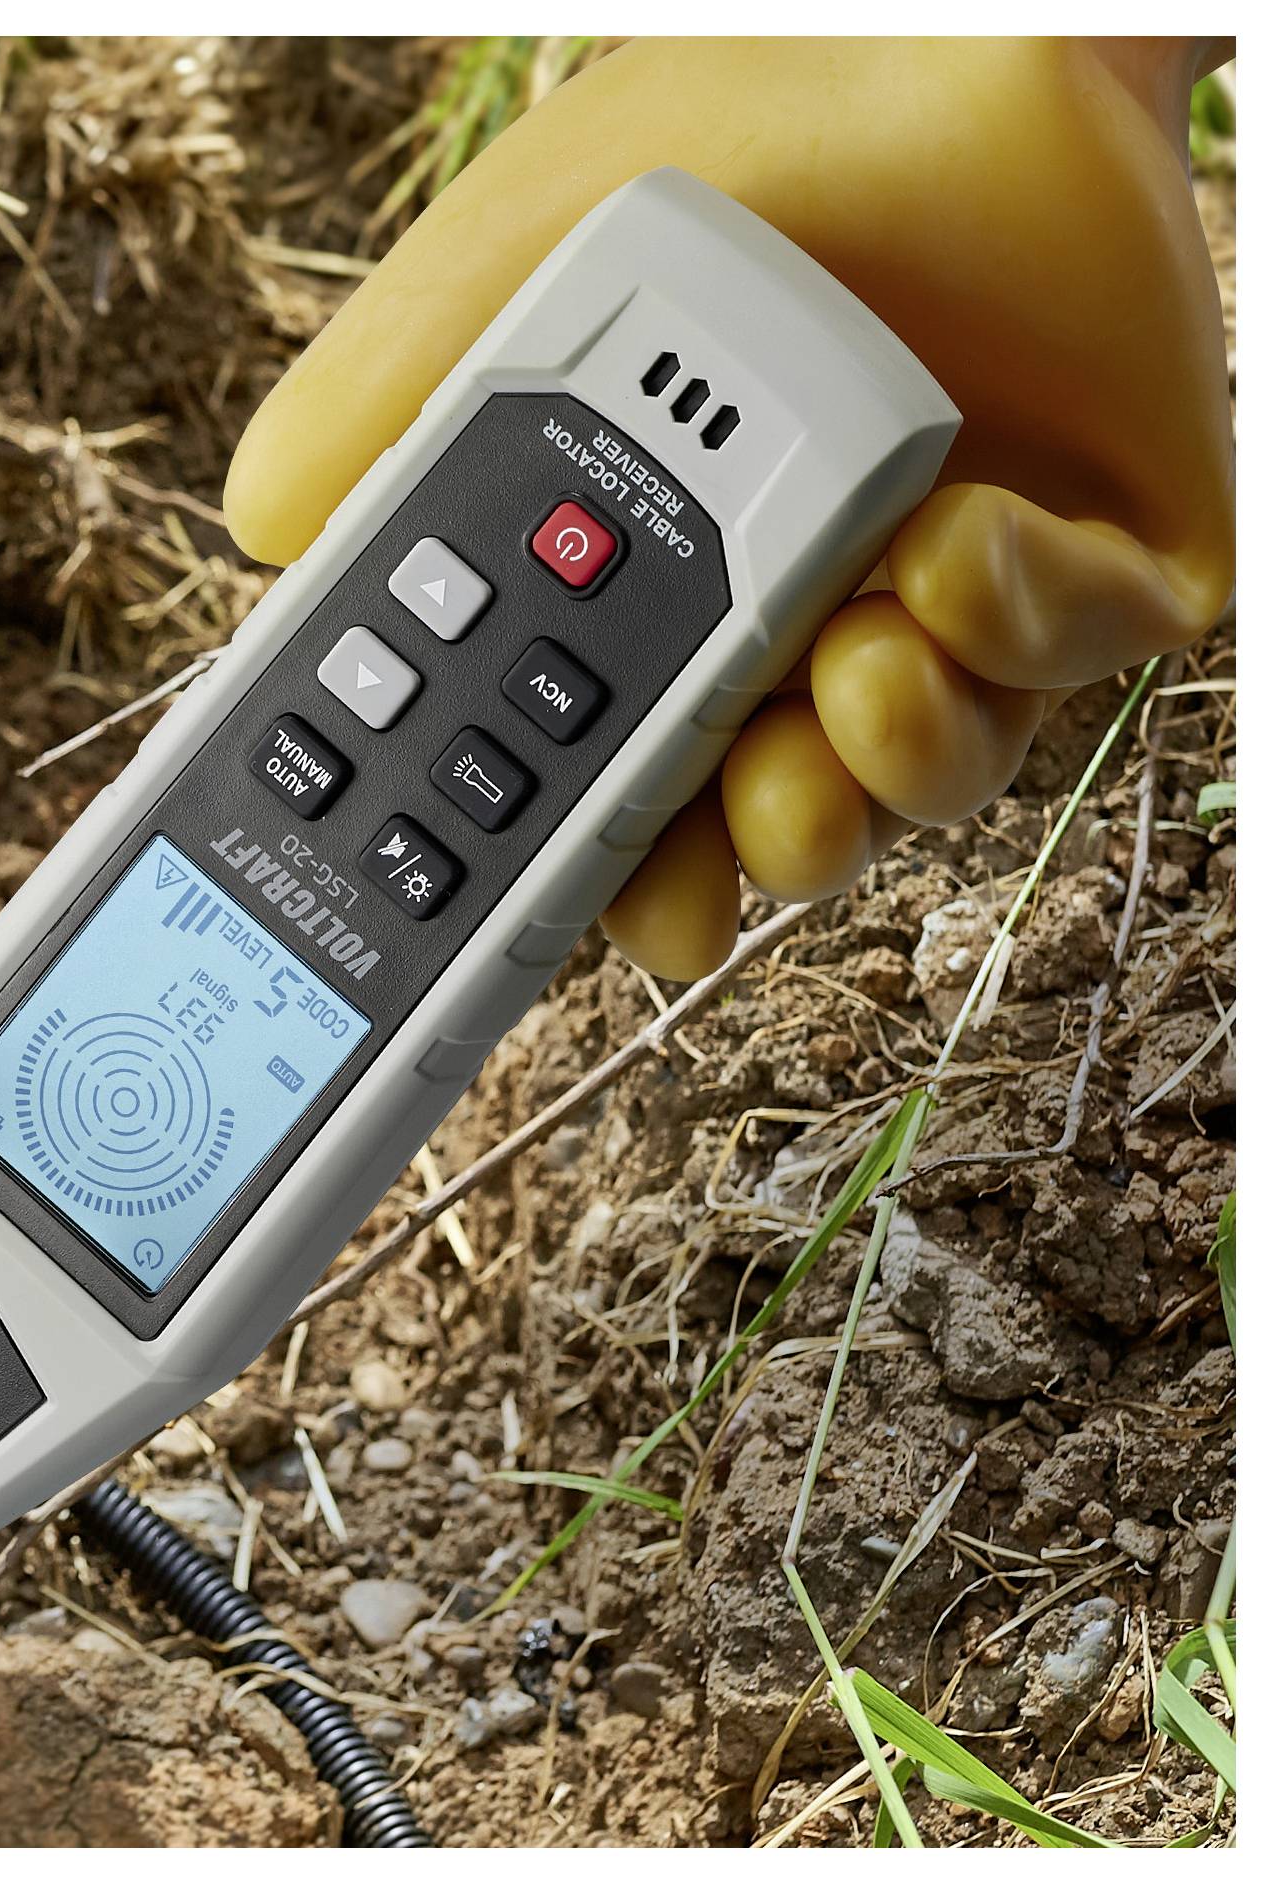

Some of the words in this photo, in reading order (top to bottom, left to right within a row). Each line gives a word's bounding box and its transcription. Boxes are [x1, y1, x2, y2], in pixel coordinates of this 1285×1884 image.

[542, 417, 631, 502] LOCATOR
[592, 429, 685, 517] RECEIVER
[630, 497, 695, 558] CABLE
[528, 673, 574, 713] NCV
[266, 757, 309, 797] AUTO
[274, 729, 333, 790] MANUAL
[280, 834, 360, 909] LSG-20
[210, 828, 382, 981] VOLTCRAFT
[217, 910, 275, 970] LEVEL
[157, 982, 225, 1045] 937
[189, 968, 239, 1012] signal
[253, 966, 305, 1018] 5
[297, 987, 350, 1040] CODE
[271, 1060, 301, 1088] AUTO
